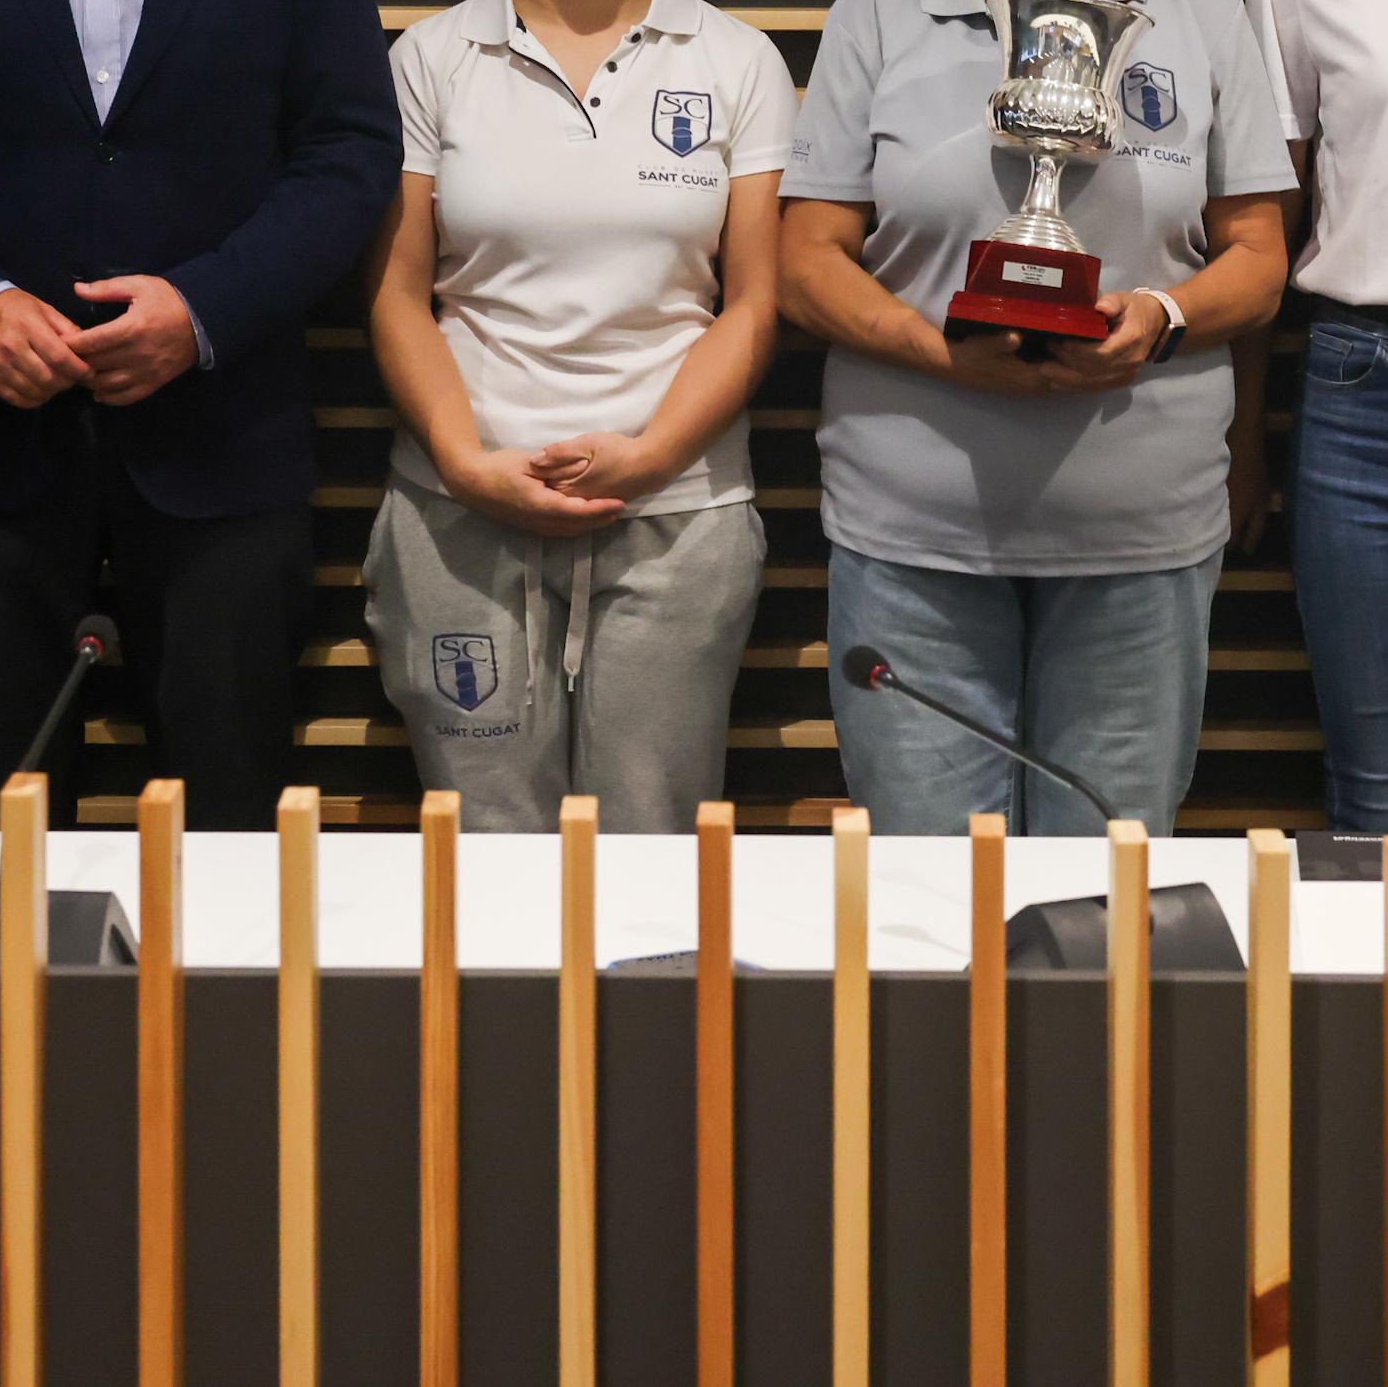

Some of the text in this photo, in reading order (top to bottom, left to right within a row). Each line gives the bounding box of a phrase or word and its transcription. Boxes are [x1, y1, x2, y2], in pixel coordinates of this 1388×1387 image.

[1128, 68, 1170, 93] SC
[659, 95, 705, 120] SC
[1154, 149, 1192, 167] CUGAT
[638, 171, 678, 183] SANT
[681, 174, 719, 189] CUGAT
[439, 639, 488, 663] SC
[436, 722, 521, 739] SANT CUGAT
